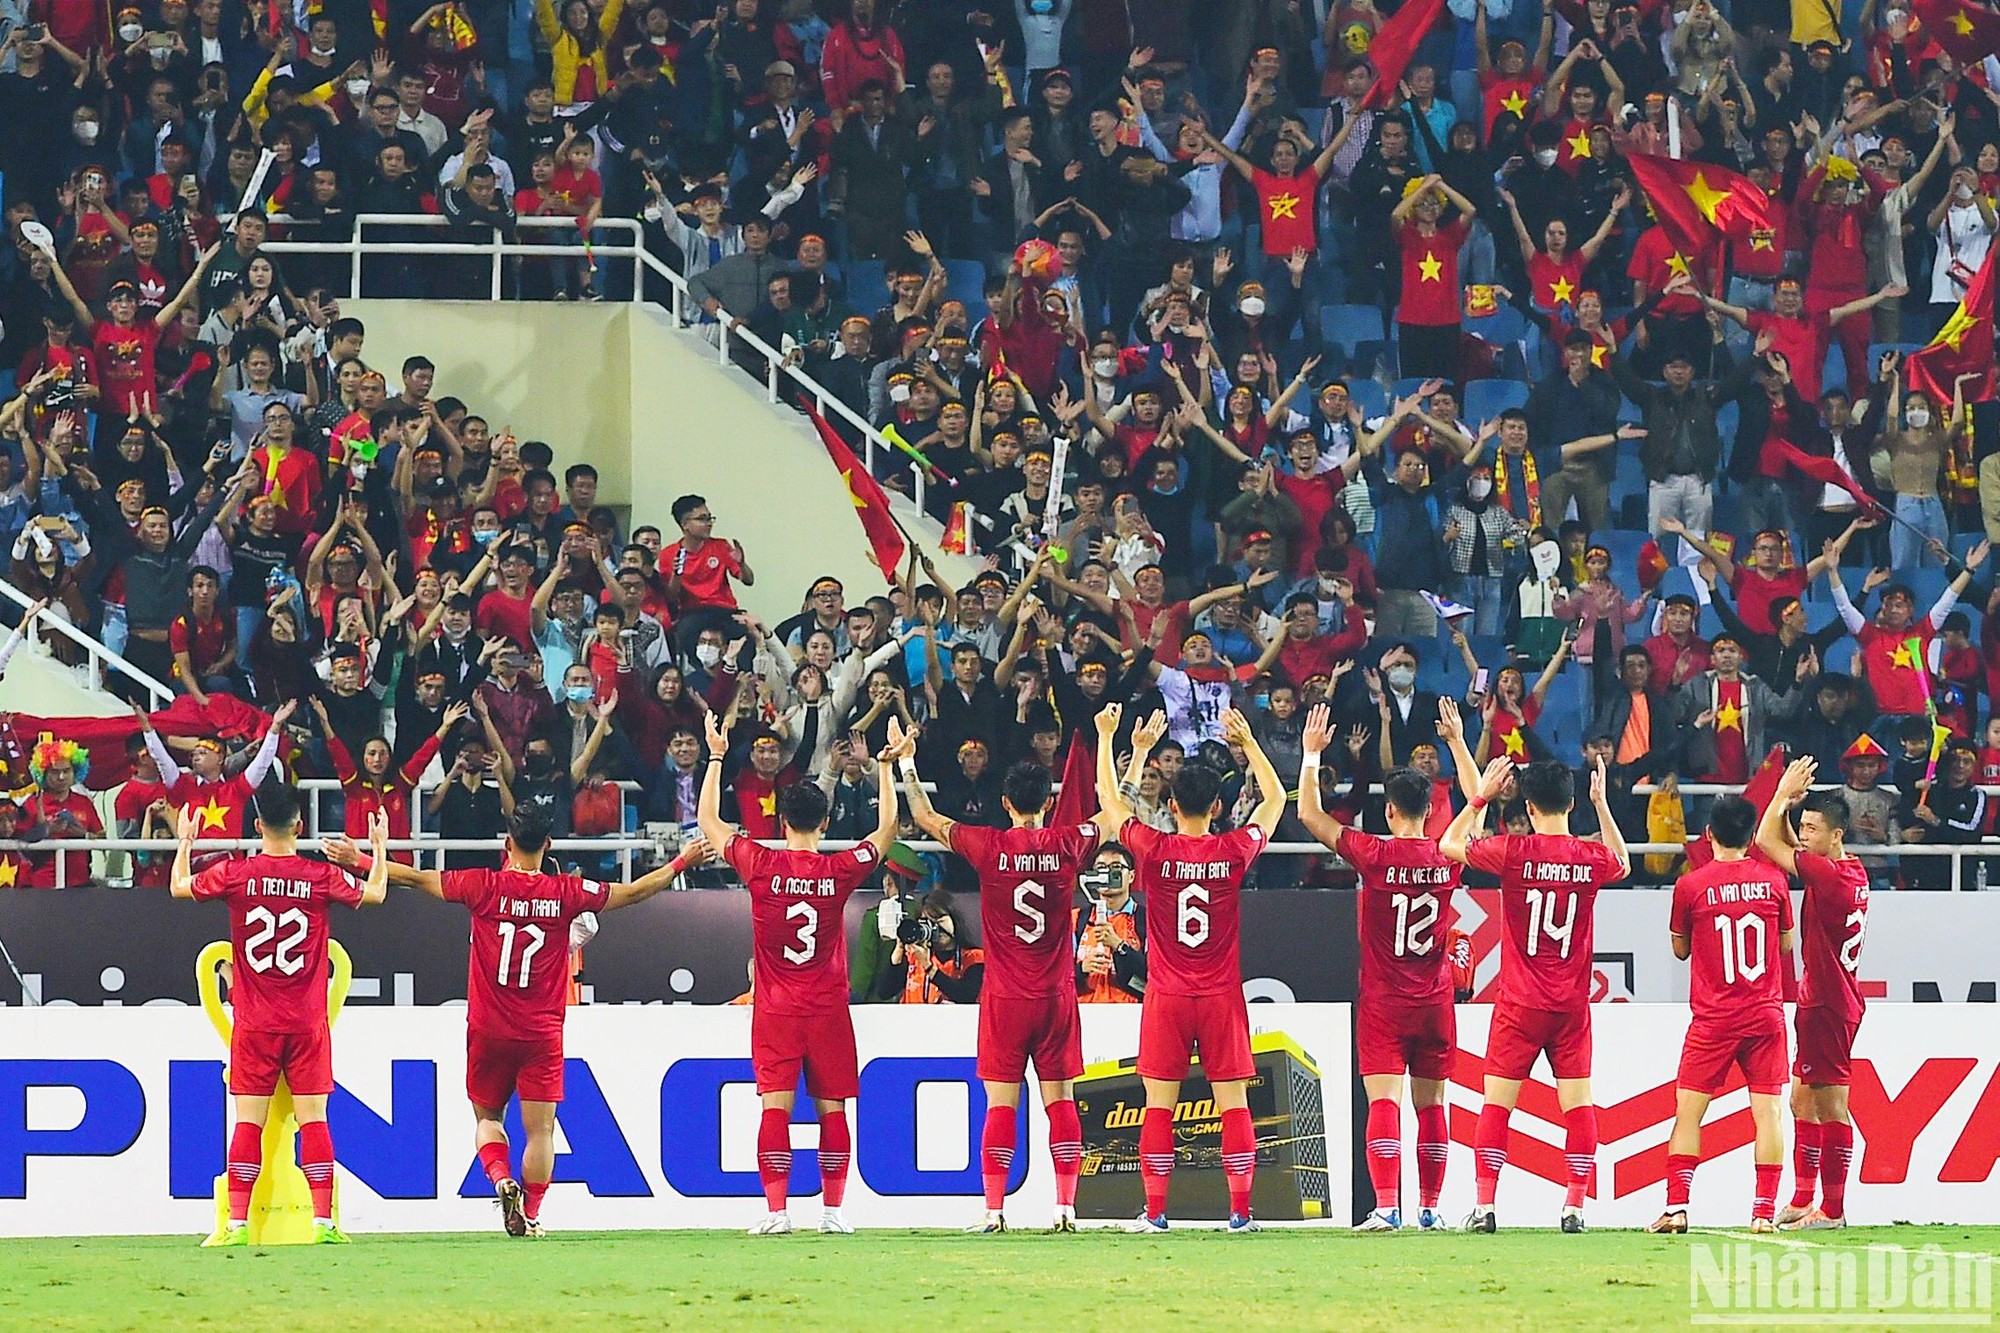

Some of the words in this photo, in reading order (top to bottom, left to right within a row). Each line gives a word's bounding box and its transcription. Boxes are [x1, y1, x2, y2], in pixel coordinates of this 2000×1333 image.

[247, 878, 257, 896] N.
[262, 877, 284, 896] TIEN
[287, 879, 311, 898] LINH
[771, 875, 781, 894] Q.
[785, 877, 814, 895] NGOC
[817, 878, 835, 896] HAI
[999, 853, 1009, 871] D.
[1014, 854, 1035, 871] VAN
[1038, 854, 1060, 871] HAU
[1161, 861, 1170, 878] N.
[1176, 861, 1206, 879] THANH
[1208, 861, 1230, 879] BINH
[1386, 866, 1395, 883] B.
[1399, 867, 1408, 884] H.
[1412, 867, 1432, 884] VIET
[1434, 866, 1450, 884] ANH
[1523, 861, 1533, 879] N.
[1537, 862, 1570, 882] HOANG
[1573, 864, 1592, 883] DUC
[1707, 887, 1718, 906] N.
[1719, 884, 1740, 903] VAN
[1741, 882, 1771, 902] QUYET
[500, 896, 507, 913] V.
[511, 898, 529, 917] VAN
[531, 899, 560, 917] THANH
[784, 900, 817, 965] 3
[1014, 879, 1045, 944] 5
[1178, 883, 1209, 948] 6
[1391, 892, 1439, 956] 12
[1526, 888, 1577, 959] 14
[245, 905, 308, 975] 22
[498, 921, 545, 988] 17
[1714, 911, 1766, 985] 10
[1840, 908, 1869, 972] 2
